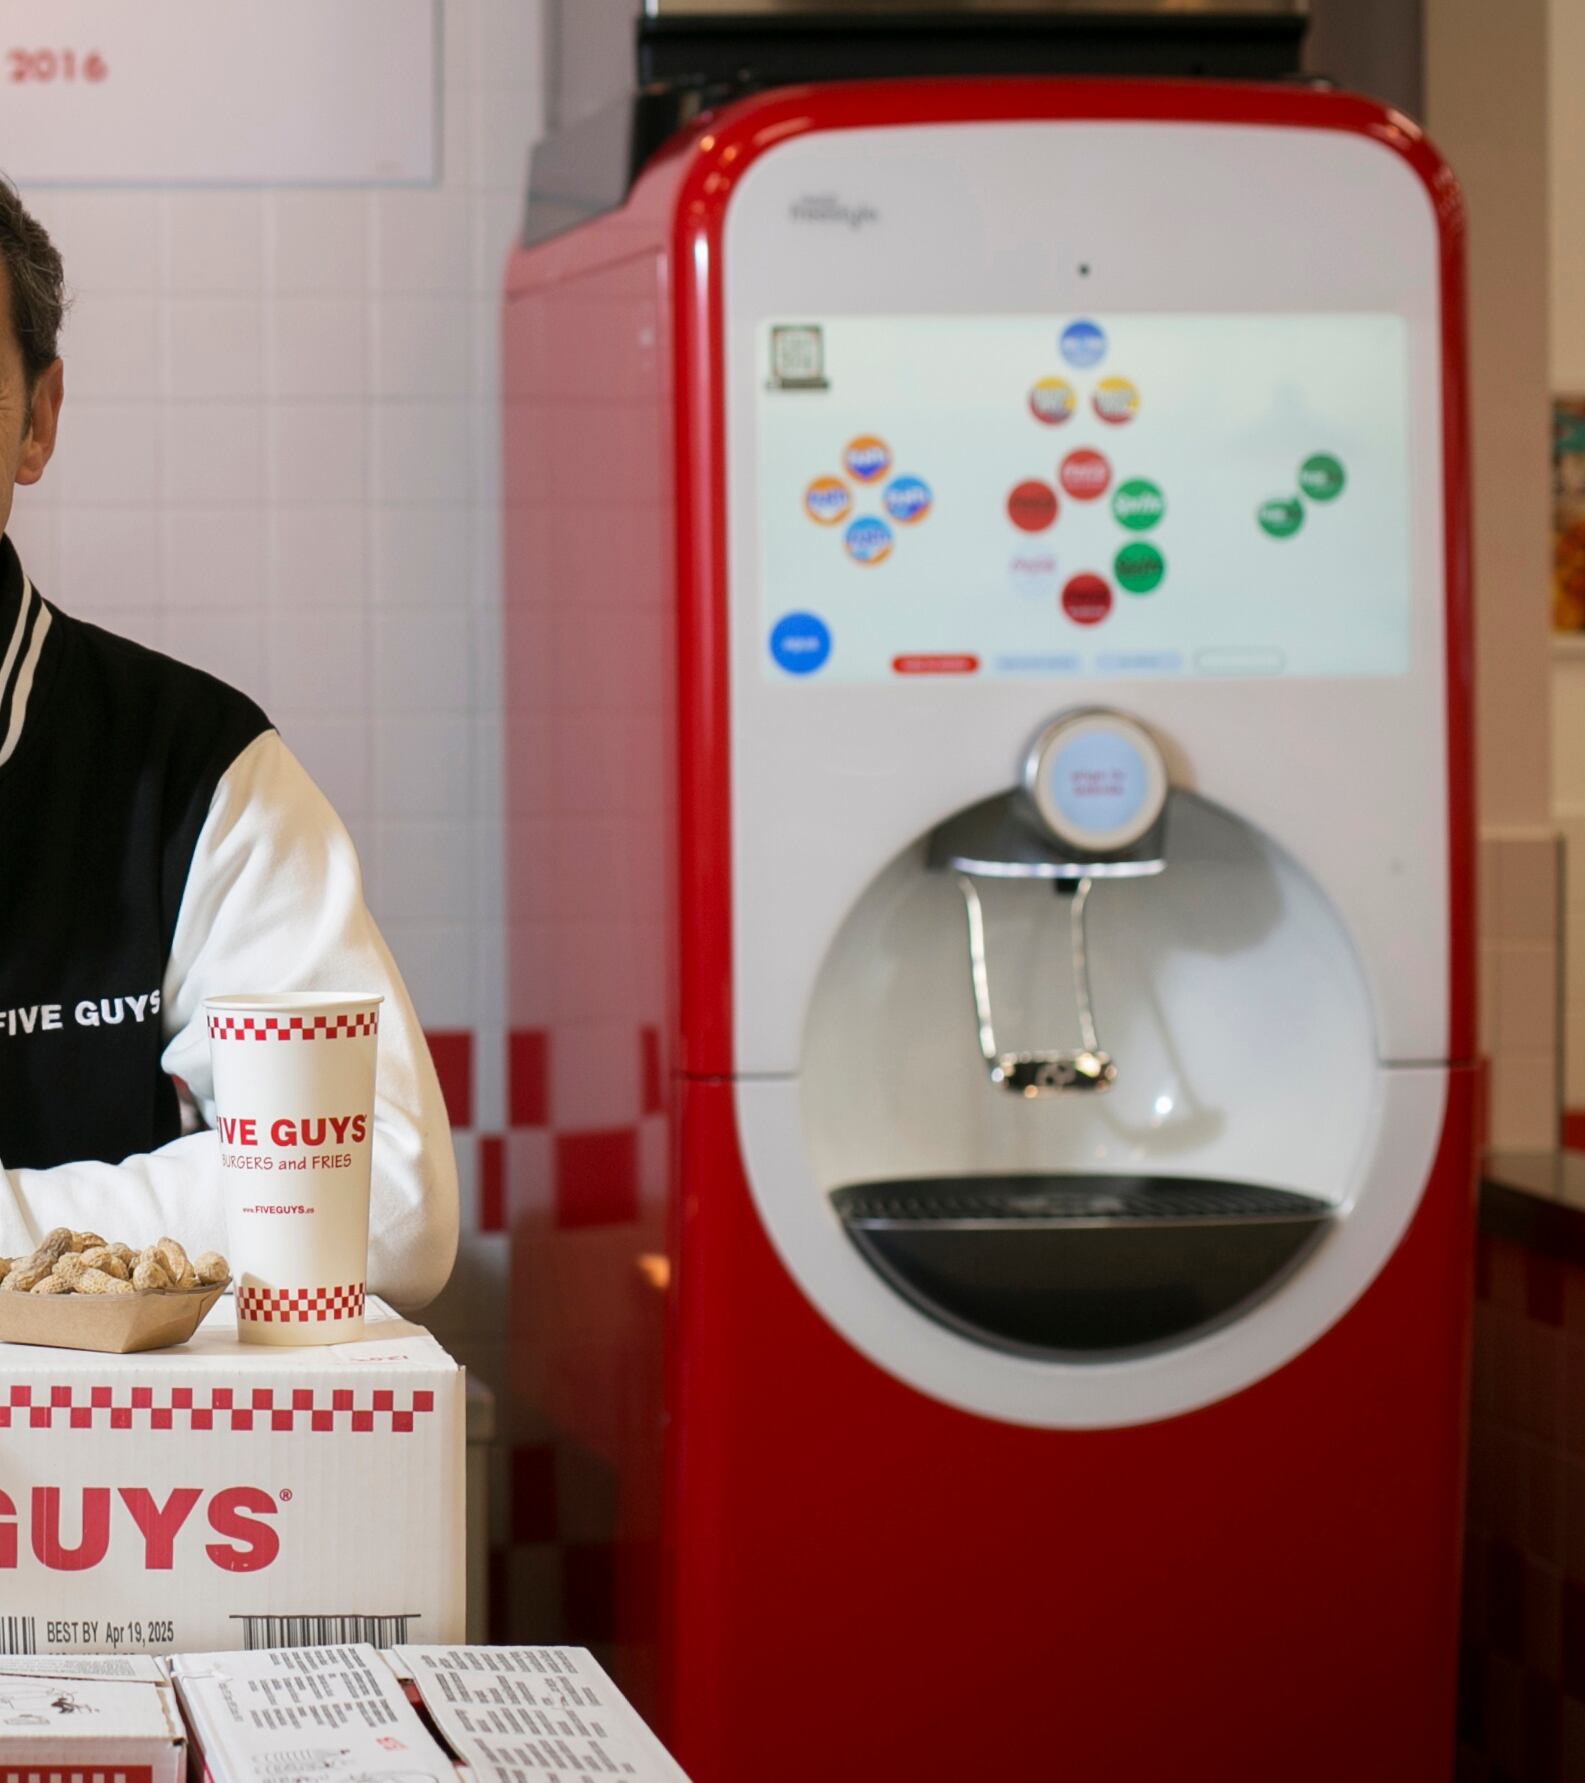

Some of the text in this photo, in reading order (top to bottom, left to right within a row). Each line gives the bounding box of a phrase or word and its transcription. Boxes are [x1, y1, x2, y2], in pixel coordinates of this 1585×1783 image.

[8, 47, 108, 84] 2016
[74, 988, 161, 1027] GUYS
[278, 1157, 307, 1171] and
[312, 1153, 352, 1170] FRIES
[47, 1621, 174, 1648] BEST BY Apr 19, 2025
